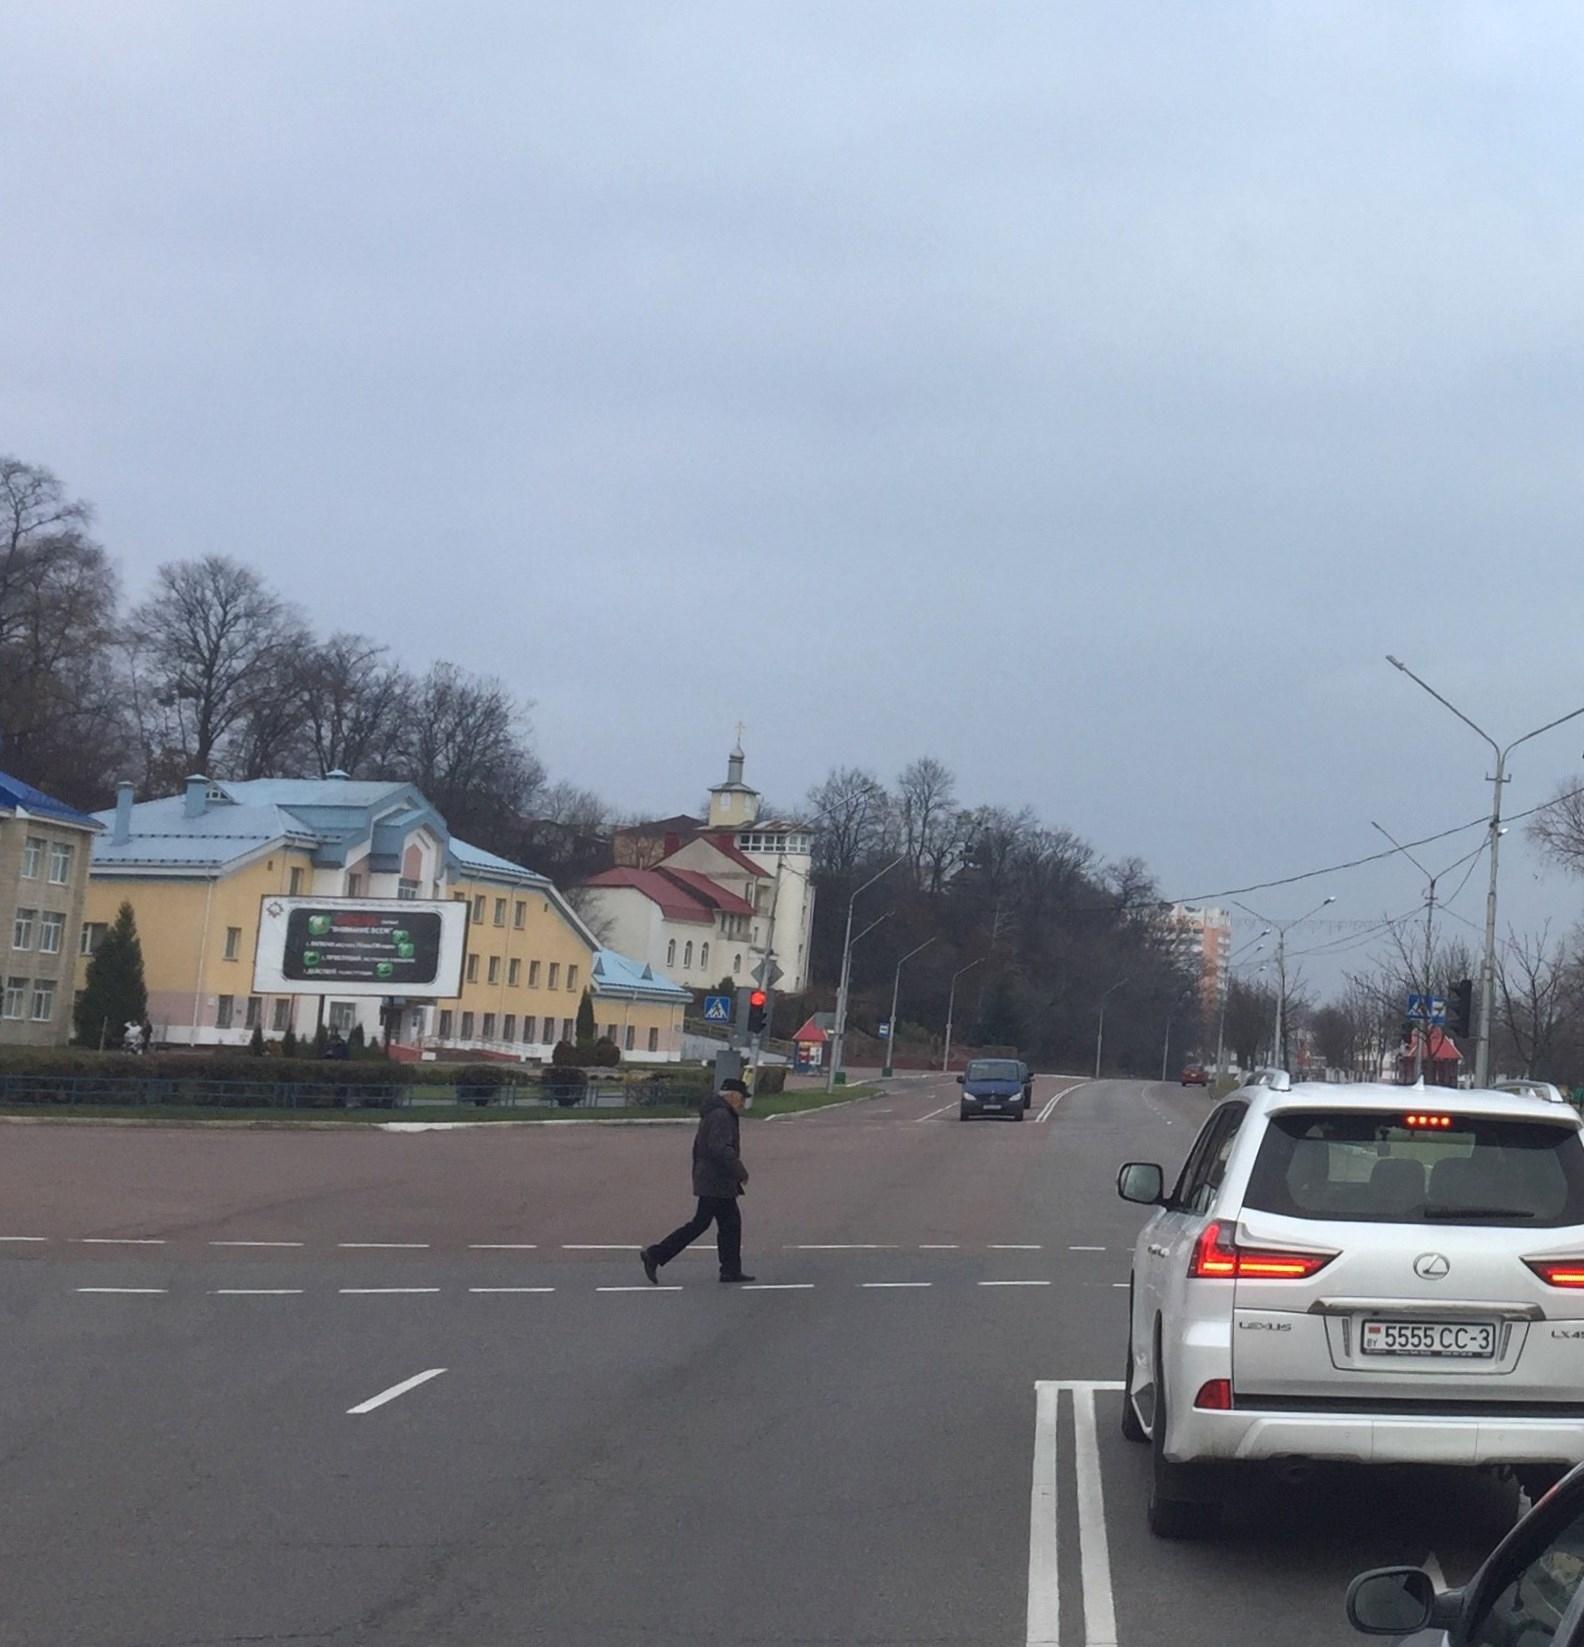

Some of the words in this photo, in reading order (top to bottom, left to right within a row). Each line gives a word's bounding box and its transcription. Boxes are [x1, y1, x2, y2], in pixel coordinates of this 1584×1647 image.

[1239, 1321, 1292, 1331] LEXUS
[1385, 1326, 1434, 1348] 5555
[1440, 1328, 1490, 1349] CC-3
